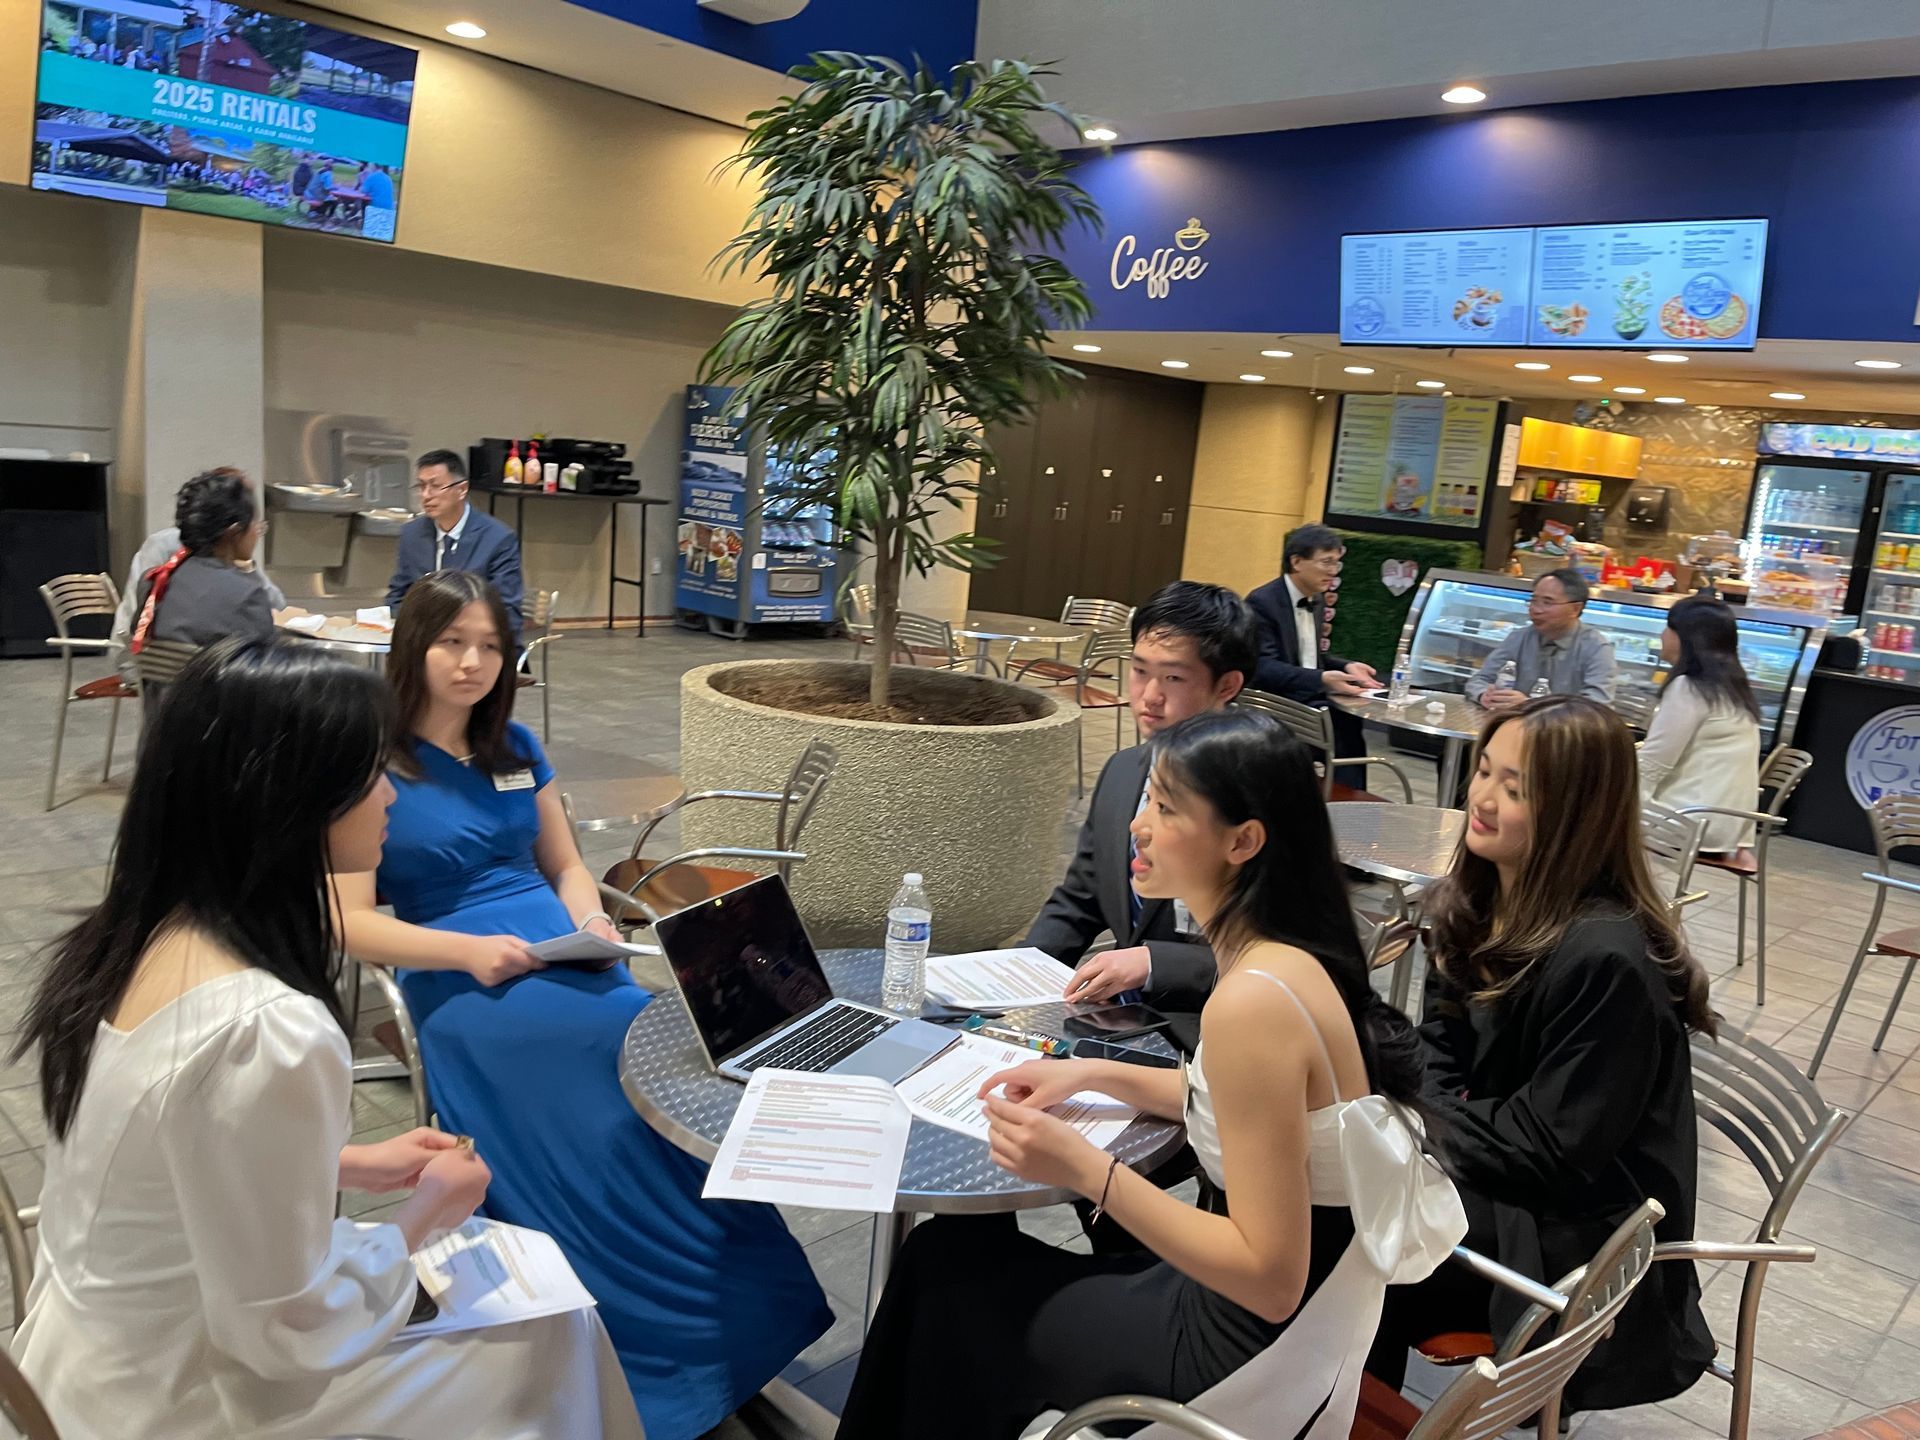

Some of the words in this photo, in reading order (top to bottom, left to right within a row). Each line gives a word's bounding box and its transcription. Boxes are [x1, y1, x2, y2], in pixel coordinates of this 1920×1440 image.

[152, 78, 215, 113] 2025
[220, 91, 318, 133] RENTALS
[1110, 234, 1210, 299] Coffee
